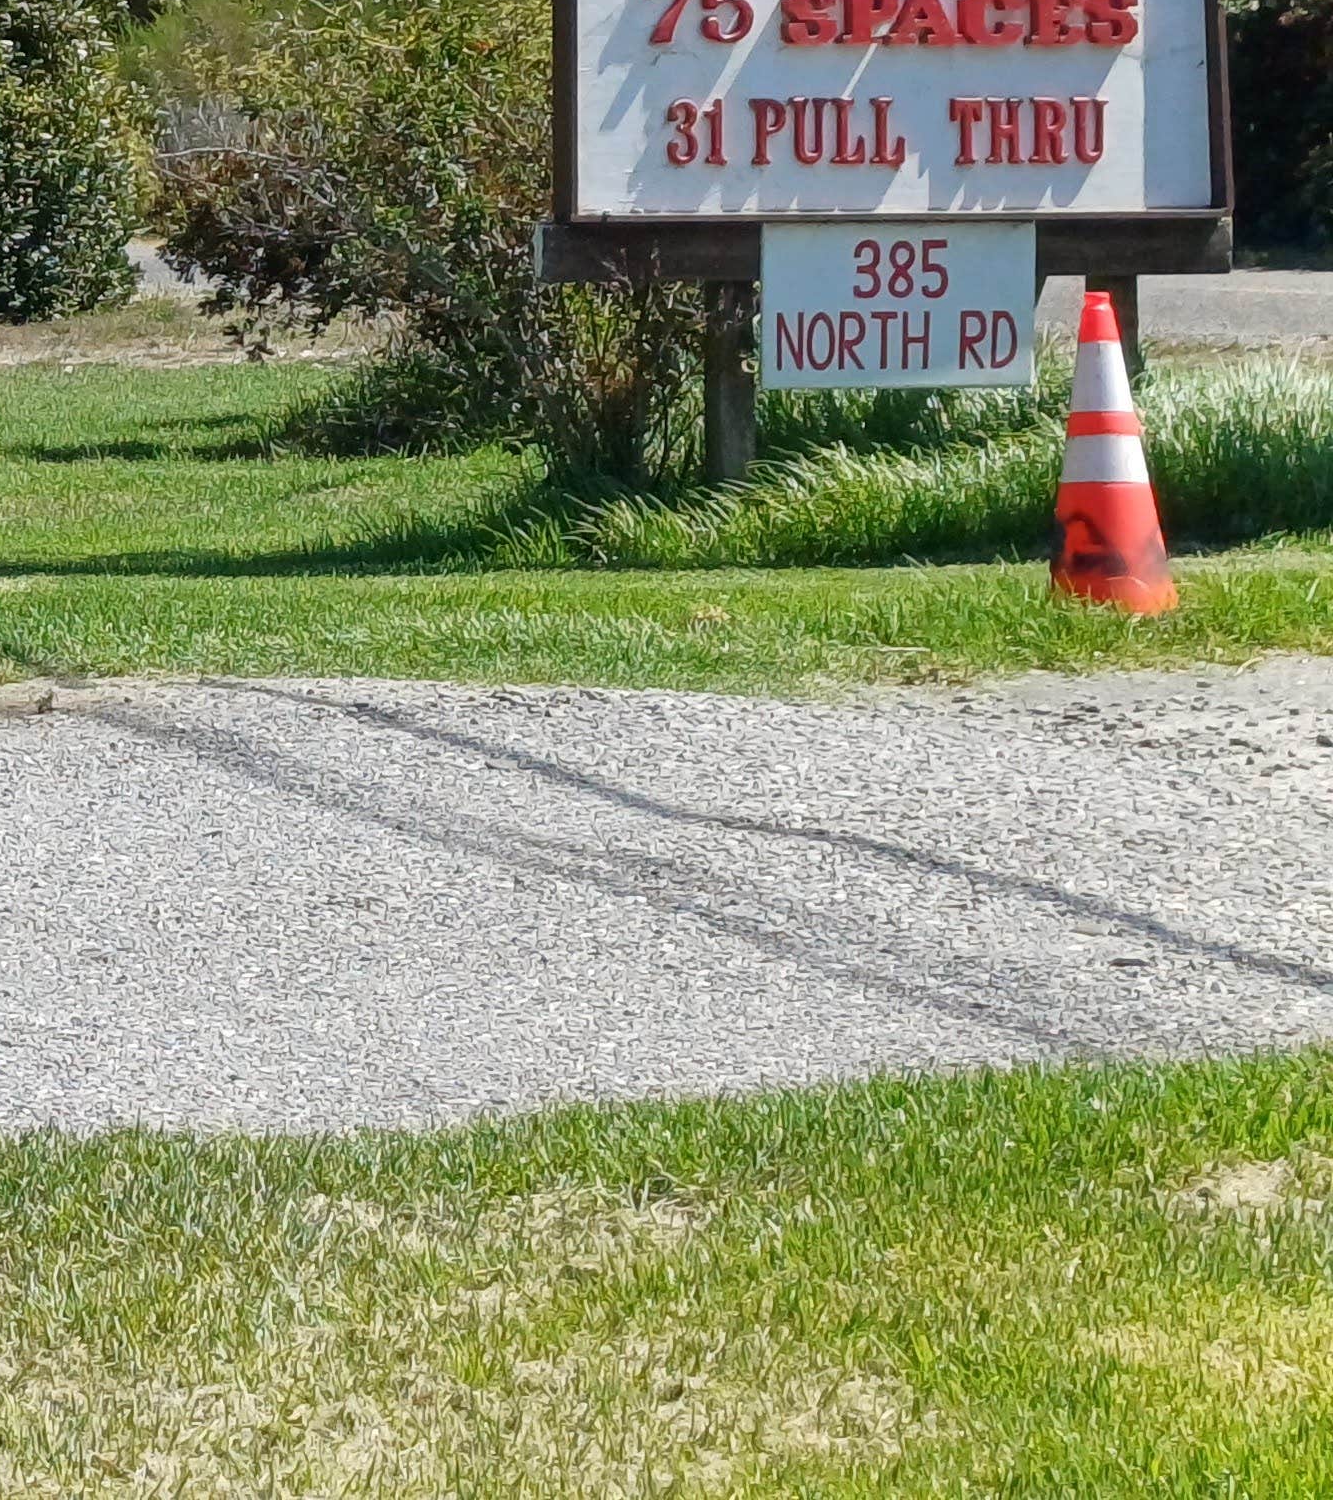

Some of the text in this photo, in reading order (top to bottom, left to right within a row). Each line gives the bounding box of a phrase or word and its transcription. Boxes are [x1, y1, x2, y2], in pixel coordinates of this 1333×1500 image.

[666, 96, 1109, 166] 31 PULL THRU
[853, 238, 949, 299] 385
[775, 309, 1018, 371] NORTH RD
